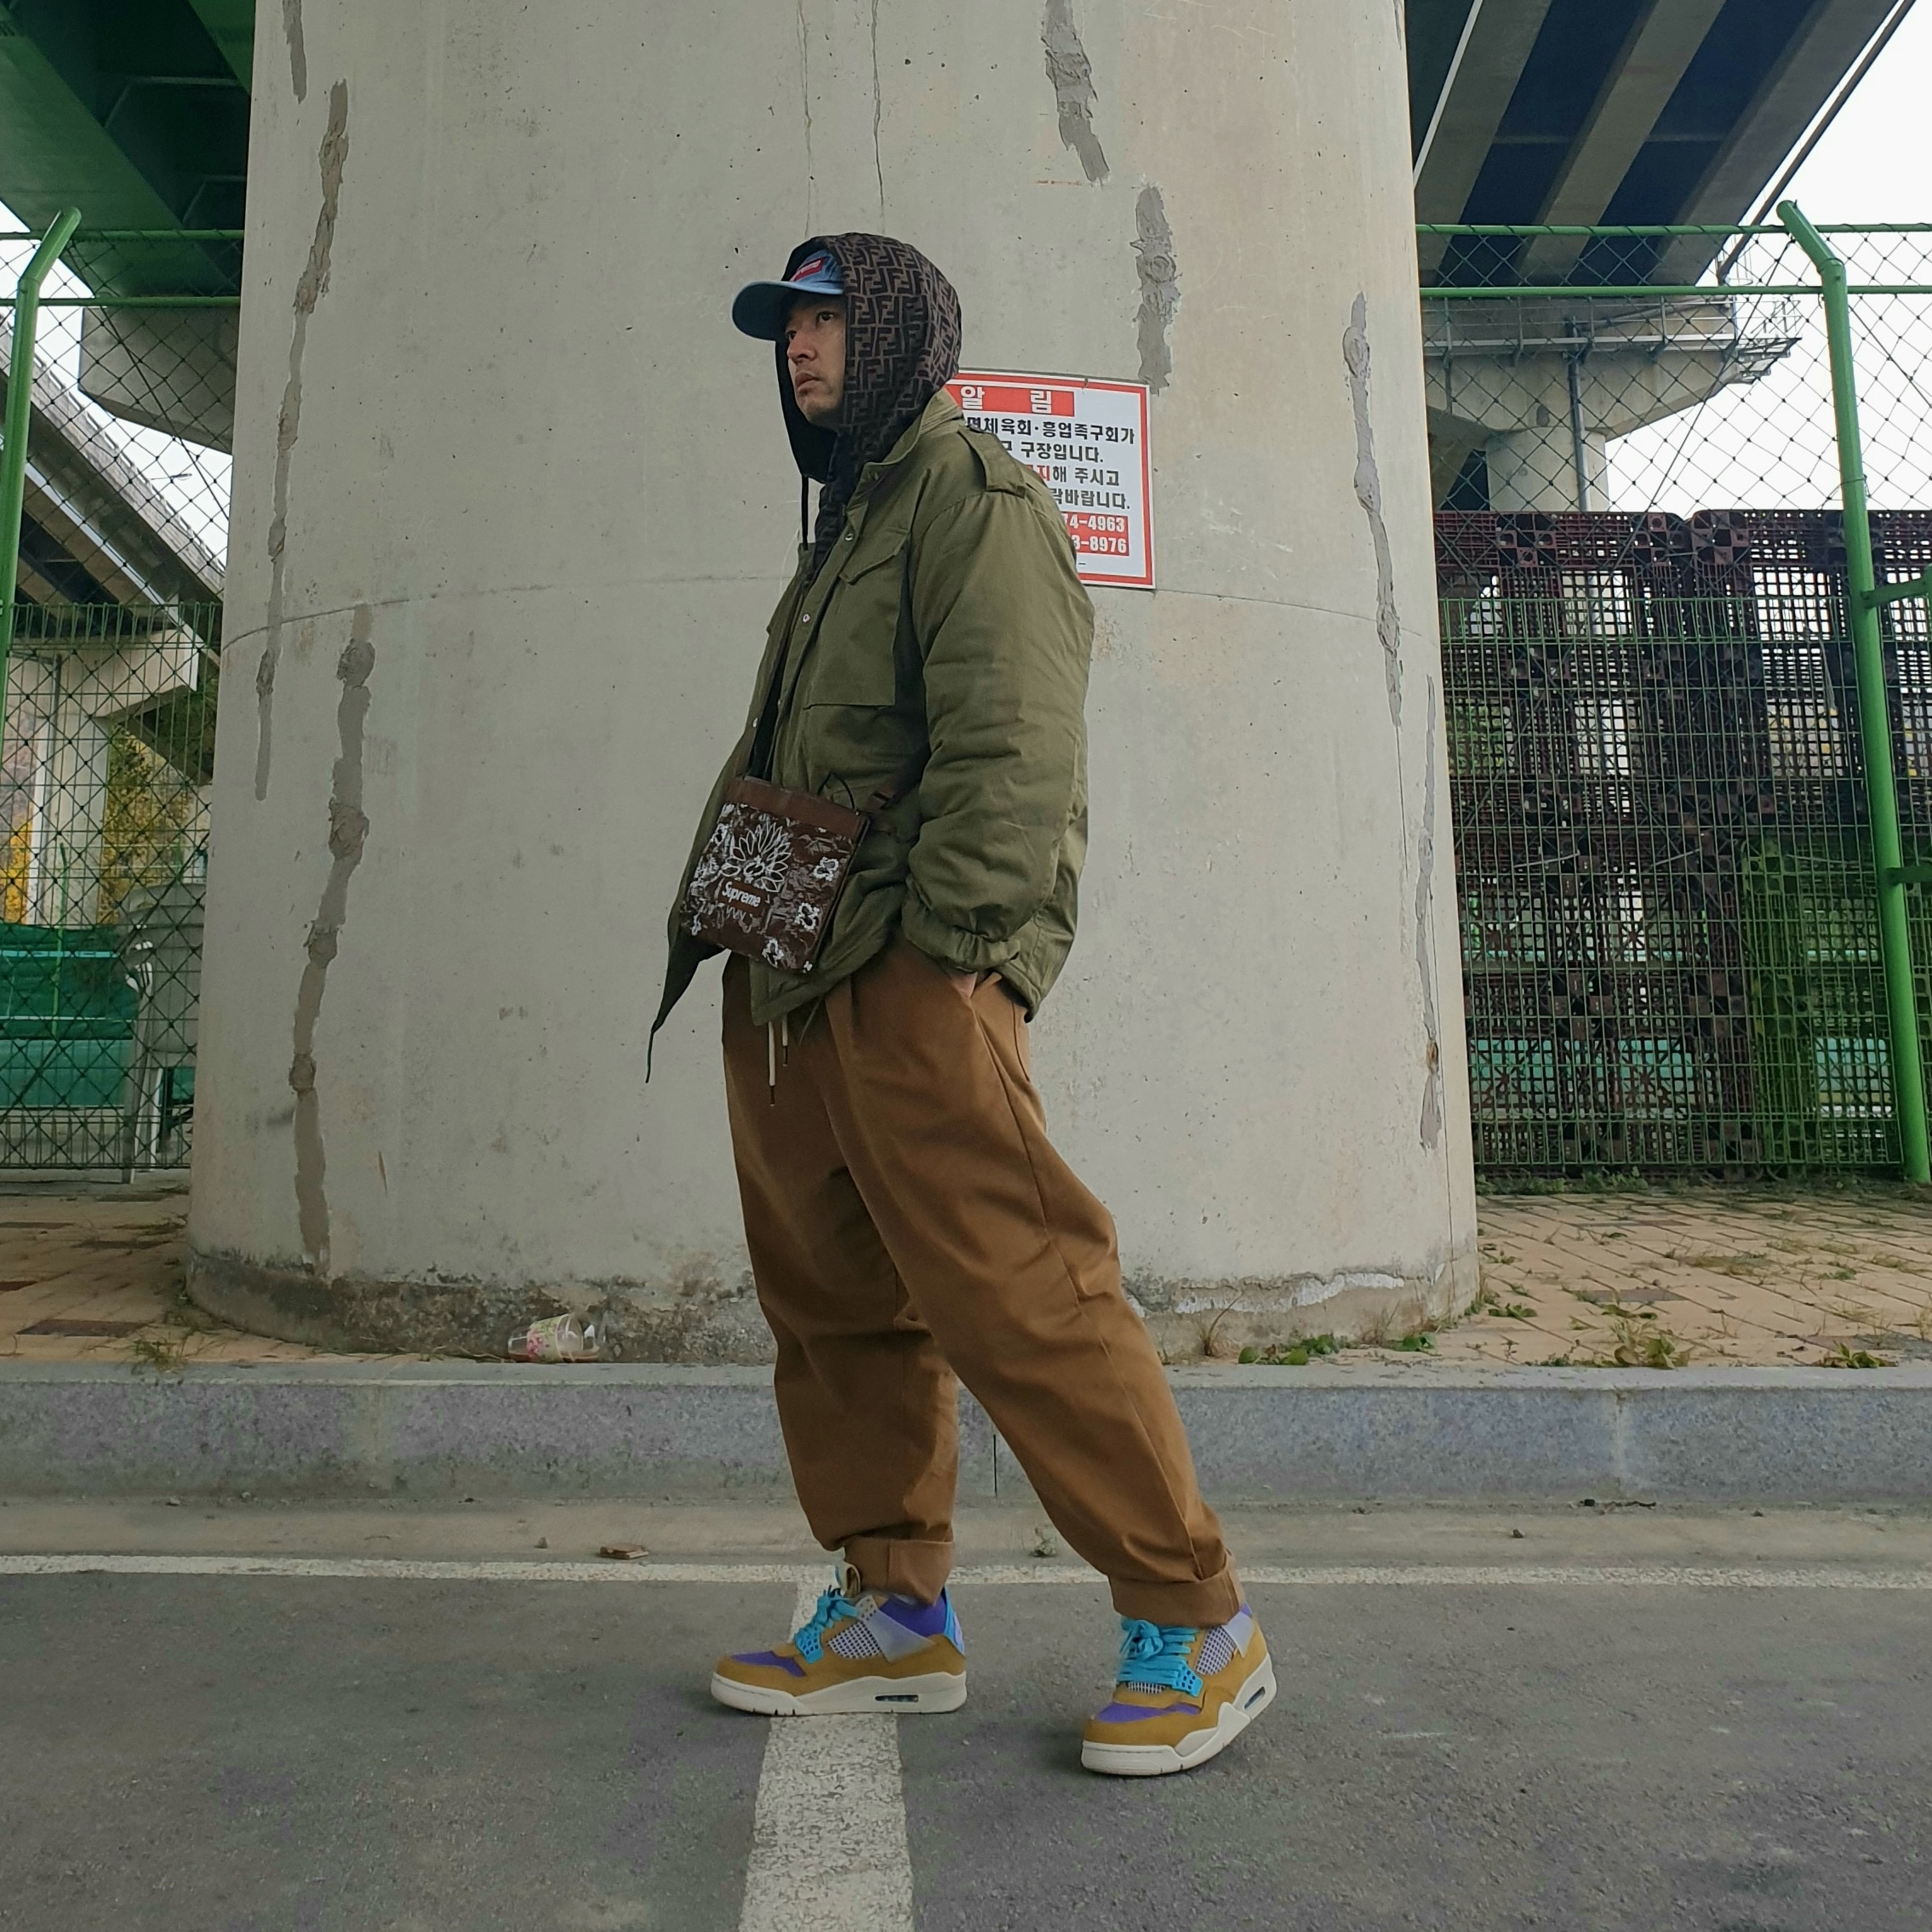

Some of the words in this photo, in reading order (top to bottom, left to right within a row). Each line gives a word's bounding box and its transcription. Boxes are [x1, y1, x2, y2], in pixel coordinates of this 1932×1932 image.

[960, 386, 986, 410] 알
[1029, 390, 1052, 414] 림
[1020, 441, 1104, 463] 구장입니다.
[1026, 464, 1066, 483] 지해
[1074, 467, 1119, 486] 주시고
[722, 881, 761, 907] Supreme
